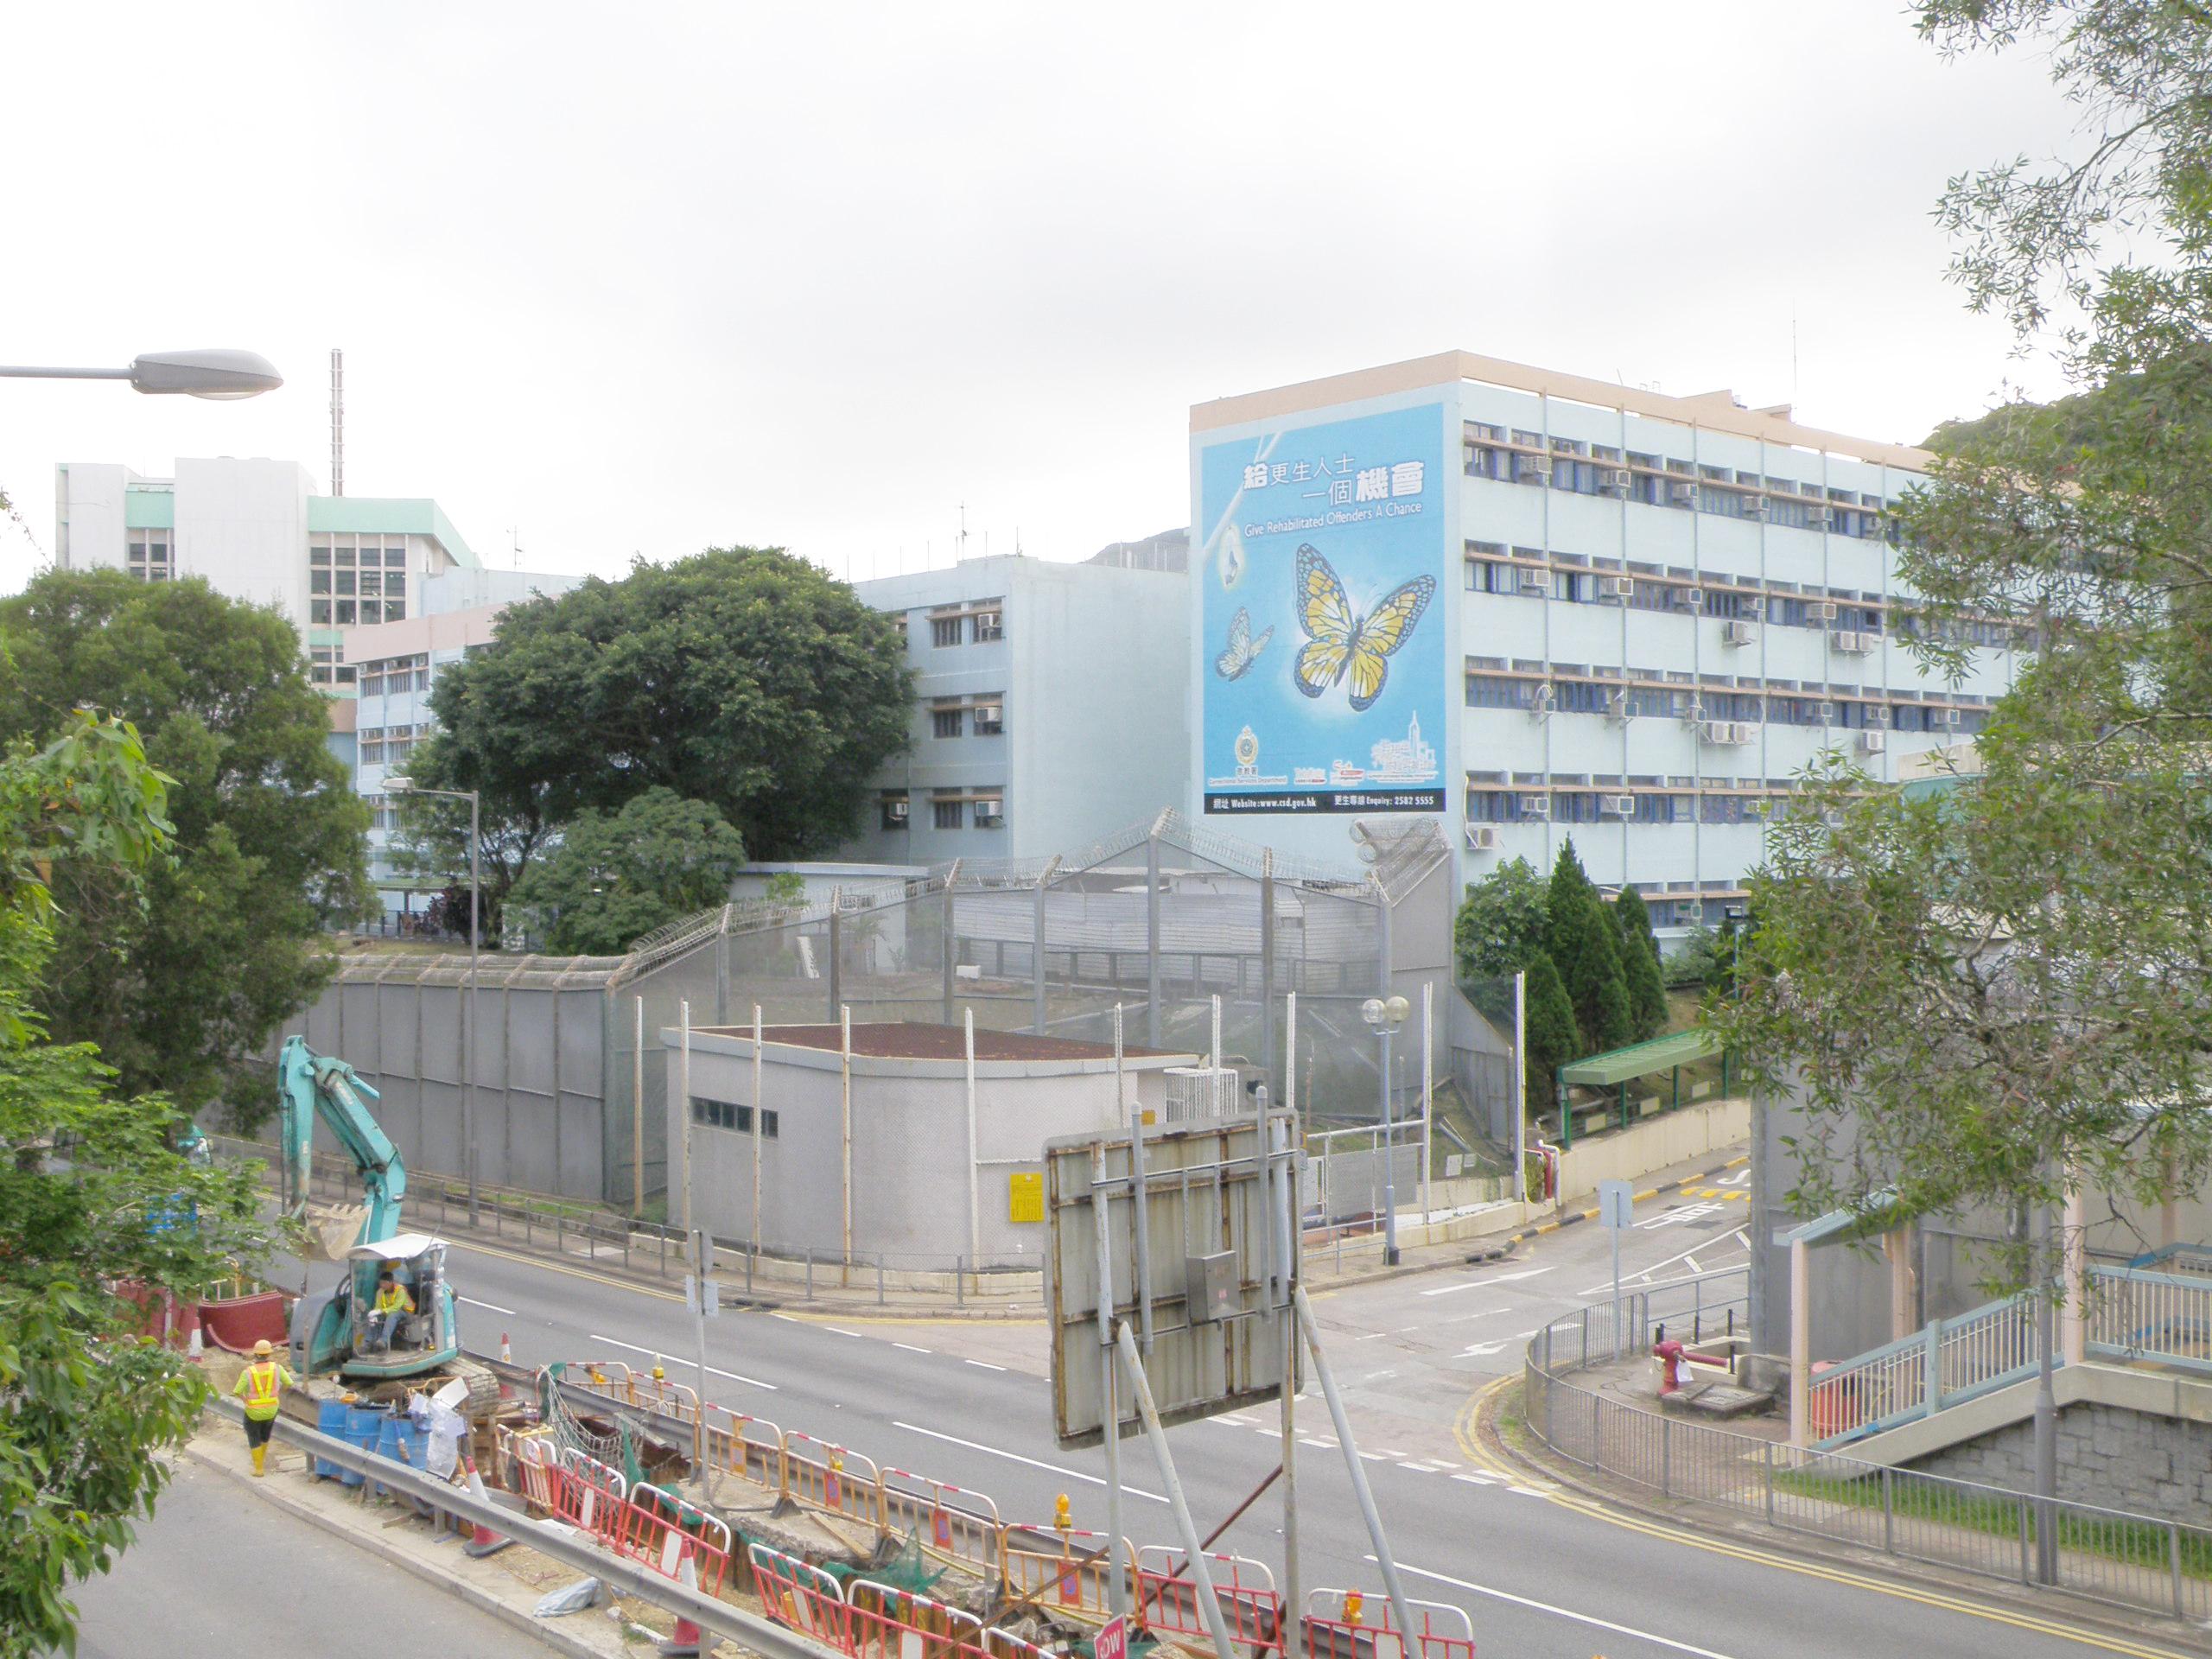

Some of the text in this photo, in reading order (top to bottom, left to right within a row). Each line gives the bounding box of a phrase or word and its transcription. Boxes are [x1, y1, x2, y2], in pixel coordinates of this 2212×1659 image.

[1243, 453, 1355, 490] 給更生人士
[1302, 461, 1424, 505] 一個機會
[1244, 502, 1422, 537] Give Rehabilitated Offenders A Chance
[1366, 796, 1393, 806] Enquiry:
[1394, 796, 1413, 805] 2582
[1414, 796, 1434, 804] 5555
